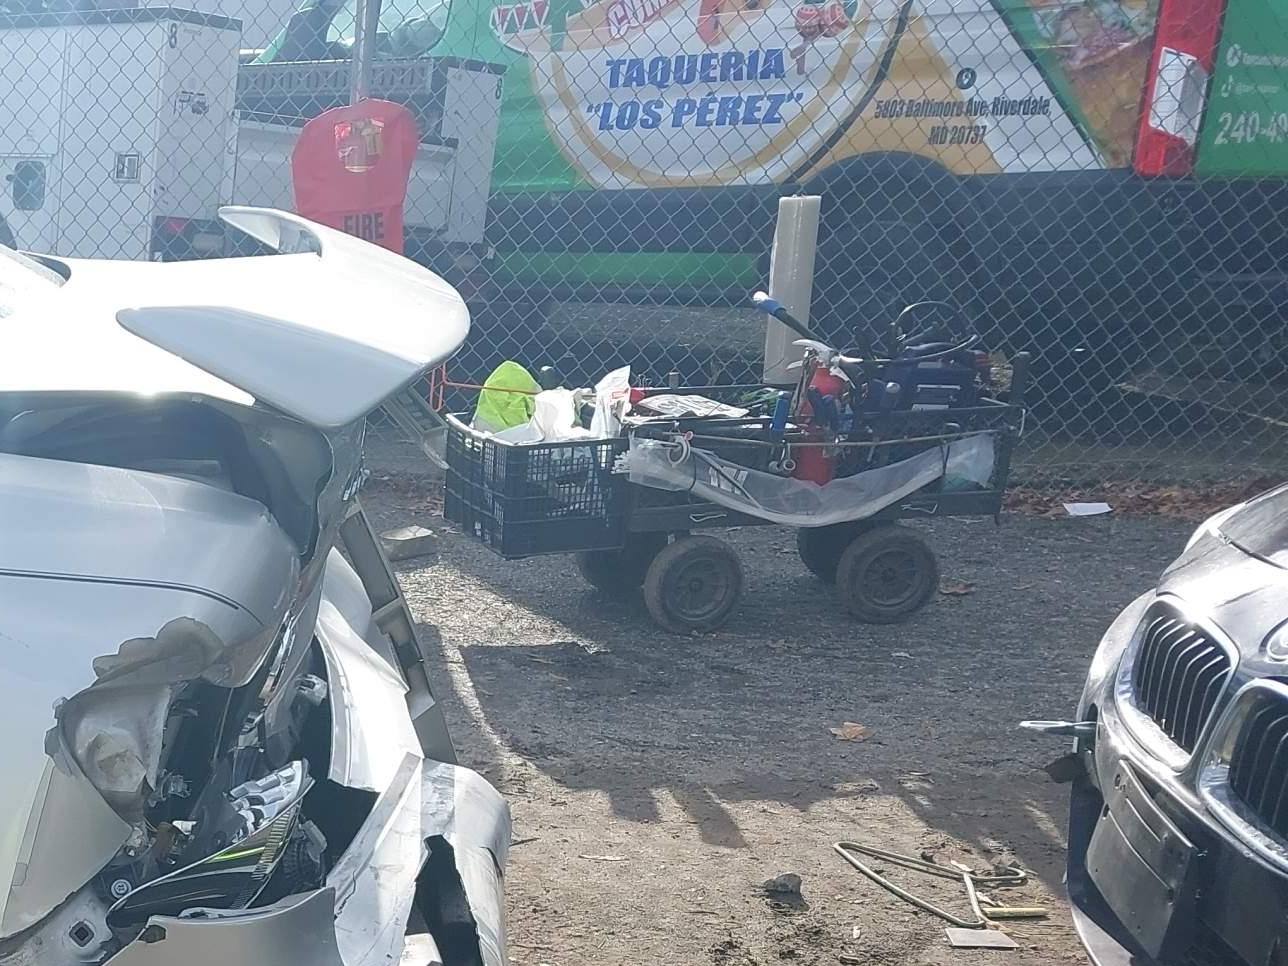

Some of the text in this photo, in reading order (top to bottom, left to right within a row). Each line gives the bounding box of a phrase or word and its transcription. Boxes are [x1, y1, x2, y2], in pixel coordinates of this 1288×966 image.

[905, 99, 963, 118] Baltimore
[927, 126, 949, 145] MD
[344, 212, 385, 240] FIRE
